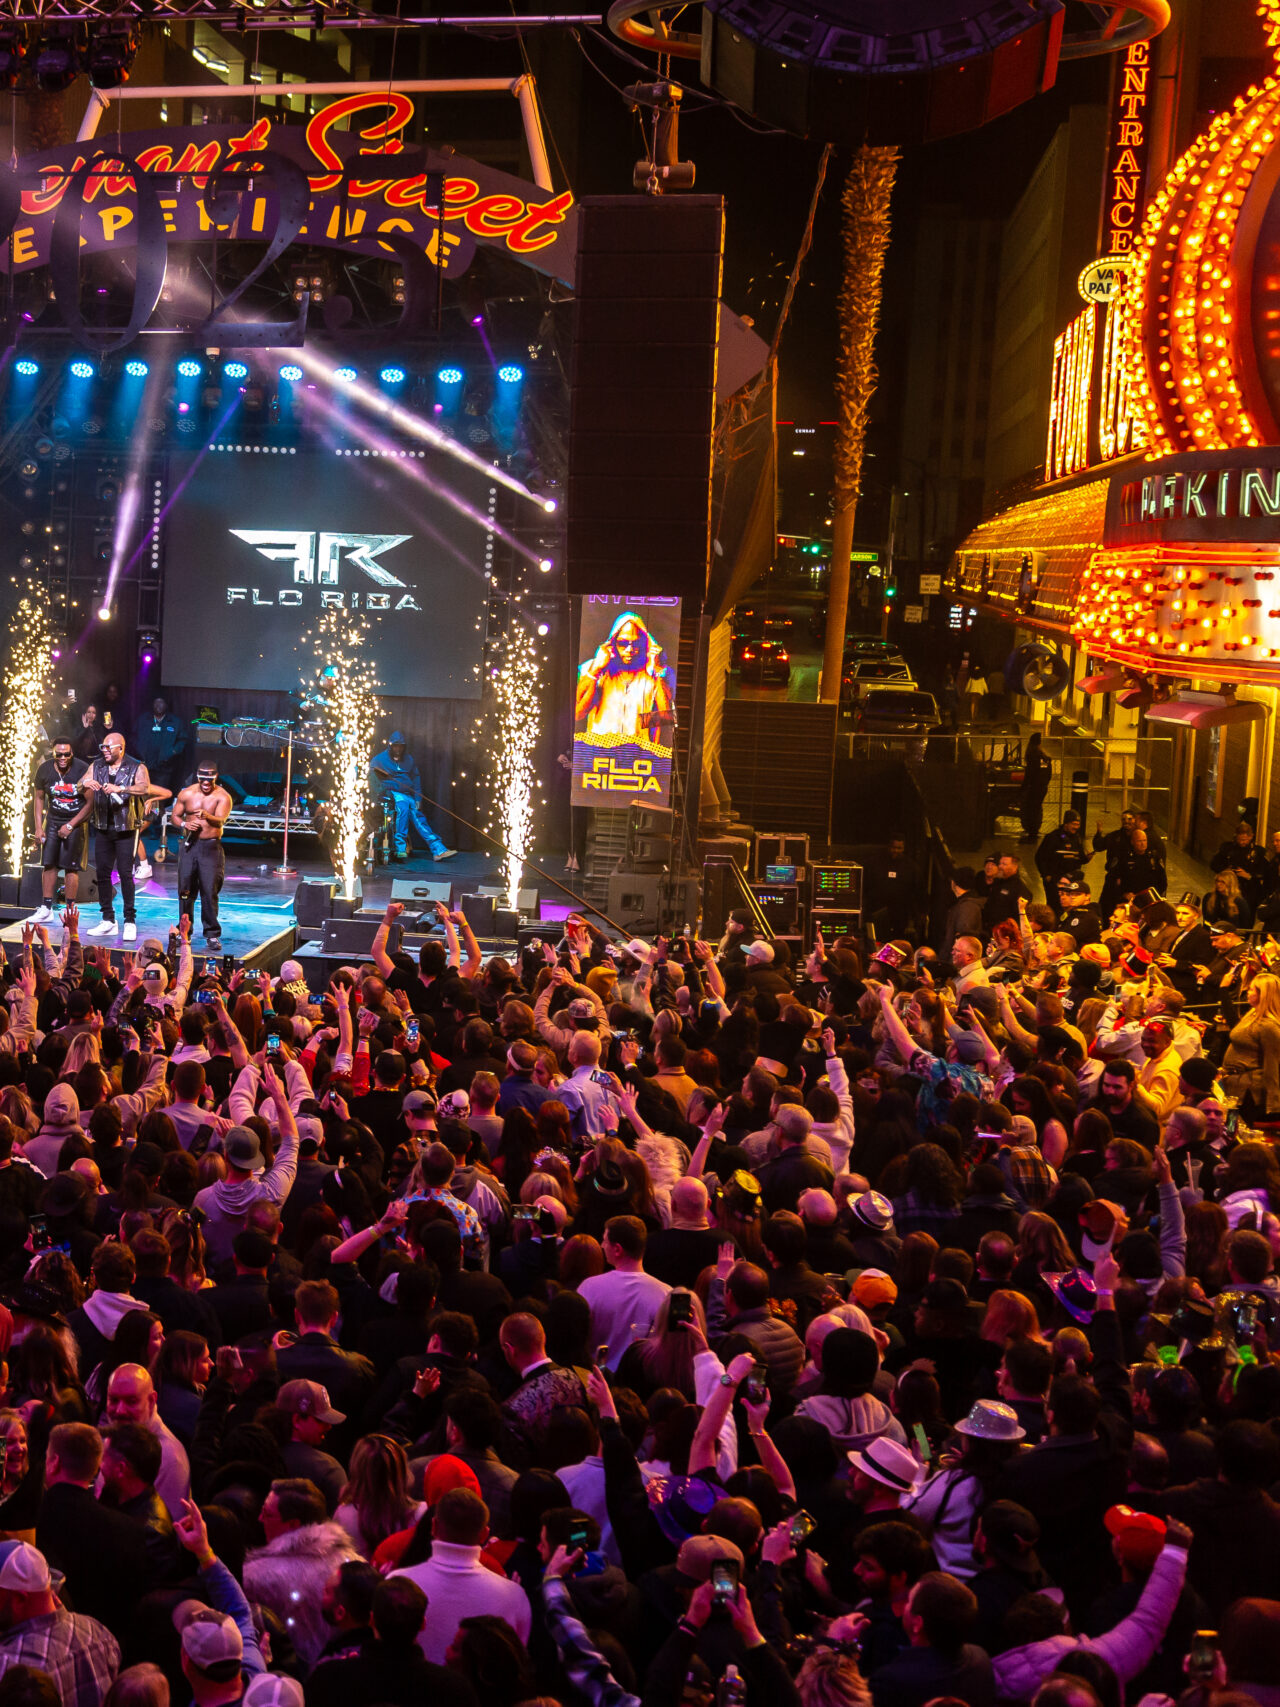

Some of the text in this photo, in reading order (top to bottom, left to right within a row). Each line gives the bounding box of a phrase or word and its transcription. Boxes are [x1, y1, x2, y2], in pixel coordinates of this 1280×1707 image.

[1108, 40, 1150, 254] ENTRANCE
[8, 196, 461, 268] EPEINCE
[226, 587, 303, 607] FLO
[593, 757, 653, 776] FLO
[581, 773, 662, 793] RIDA
